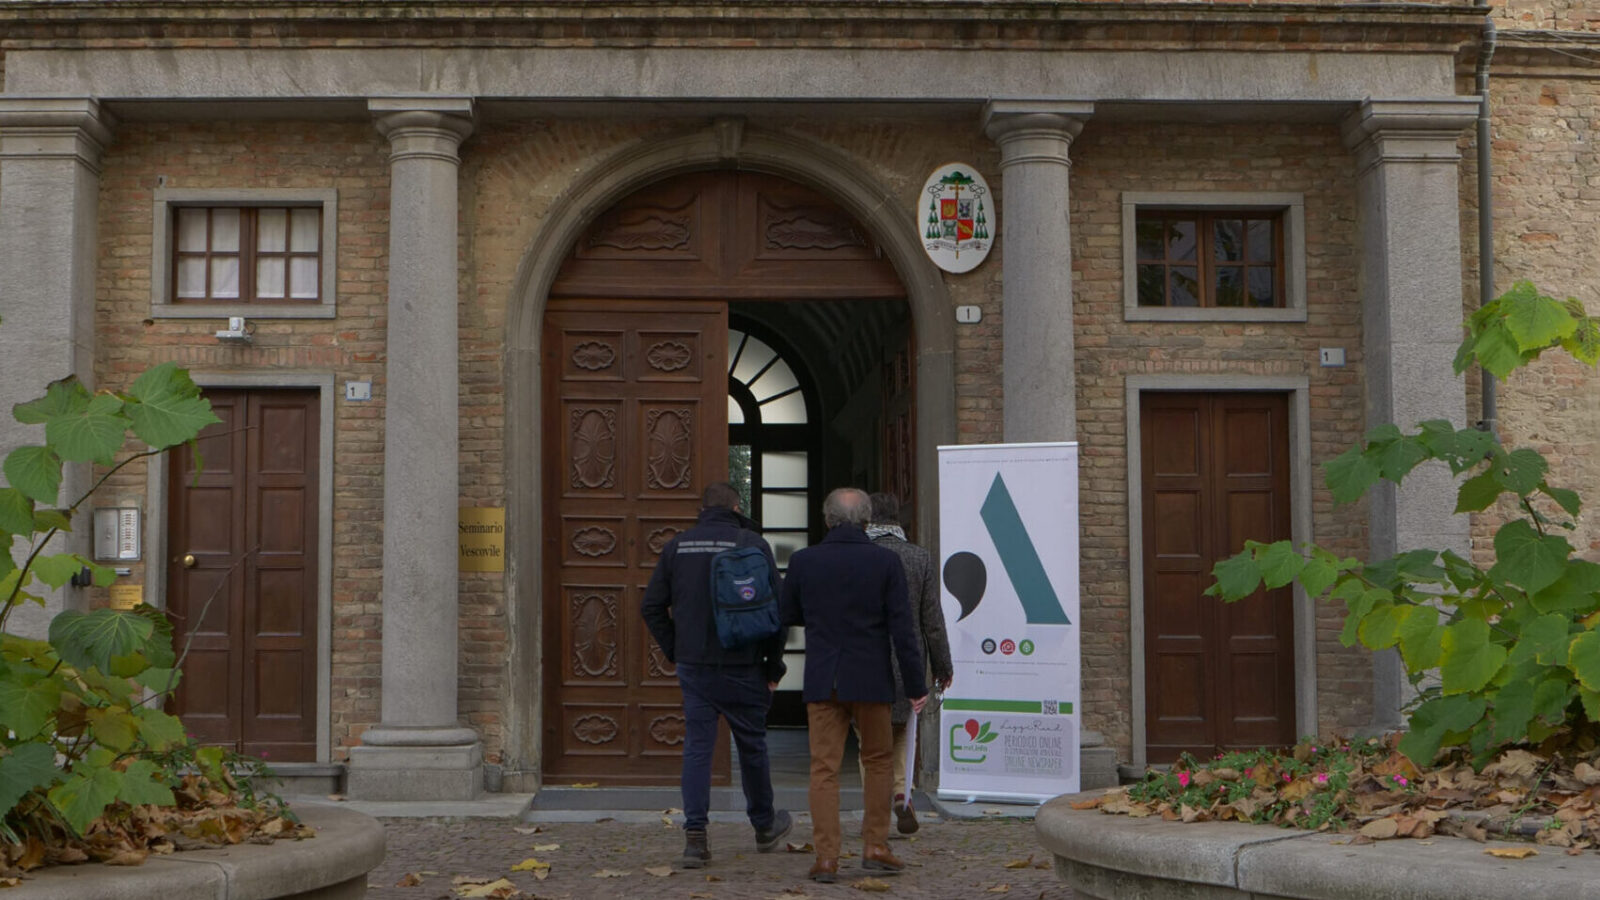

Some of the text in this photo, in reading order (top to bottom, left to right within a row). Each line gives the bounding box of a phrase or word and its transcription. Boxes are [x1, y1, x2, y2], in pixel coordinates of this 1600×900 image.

[458, 521, 503, 534] Seminario
[460, 544, 501, 557] Vescovile
[1039, 736, 1062, 750] ONLINE
